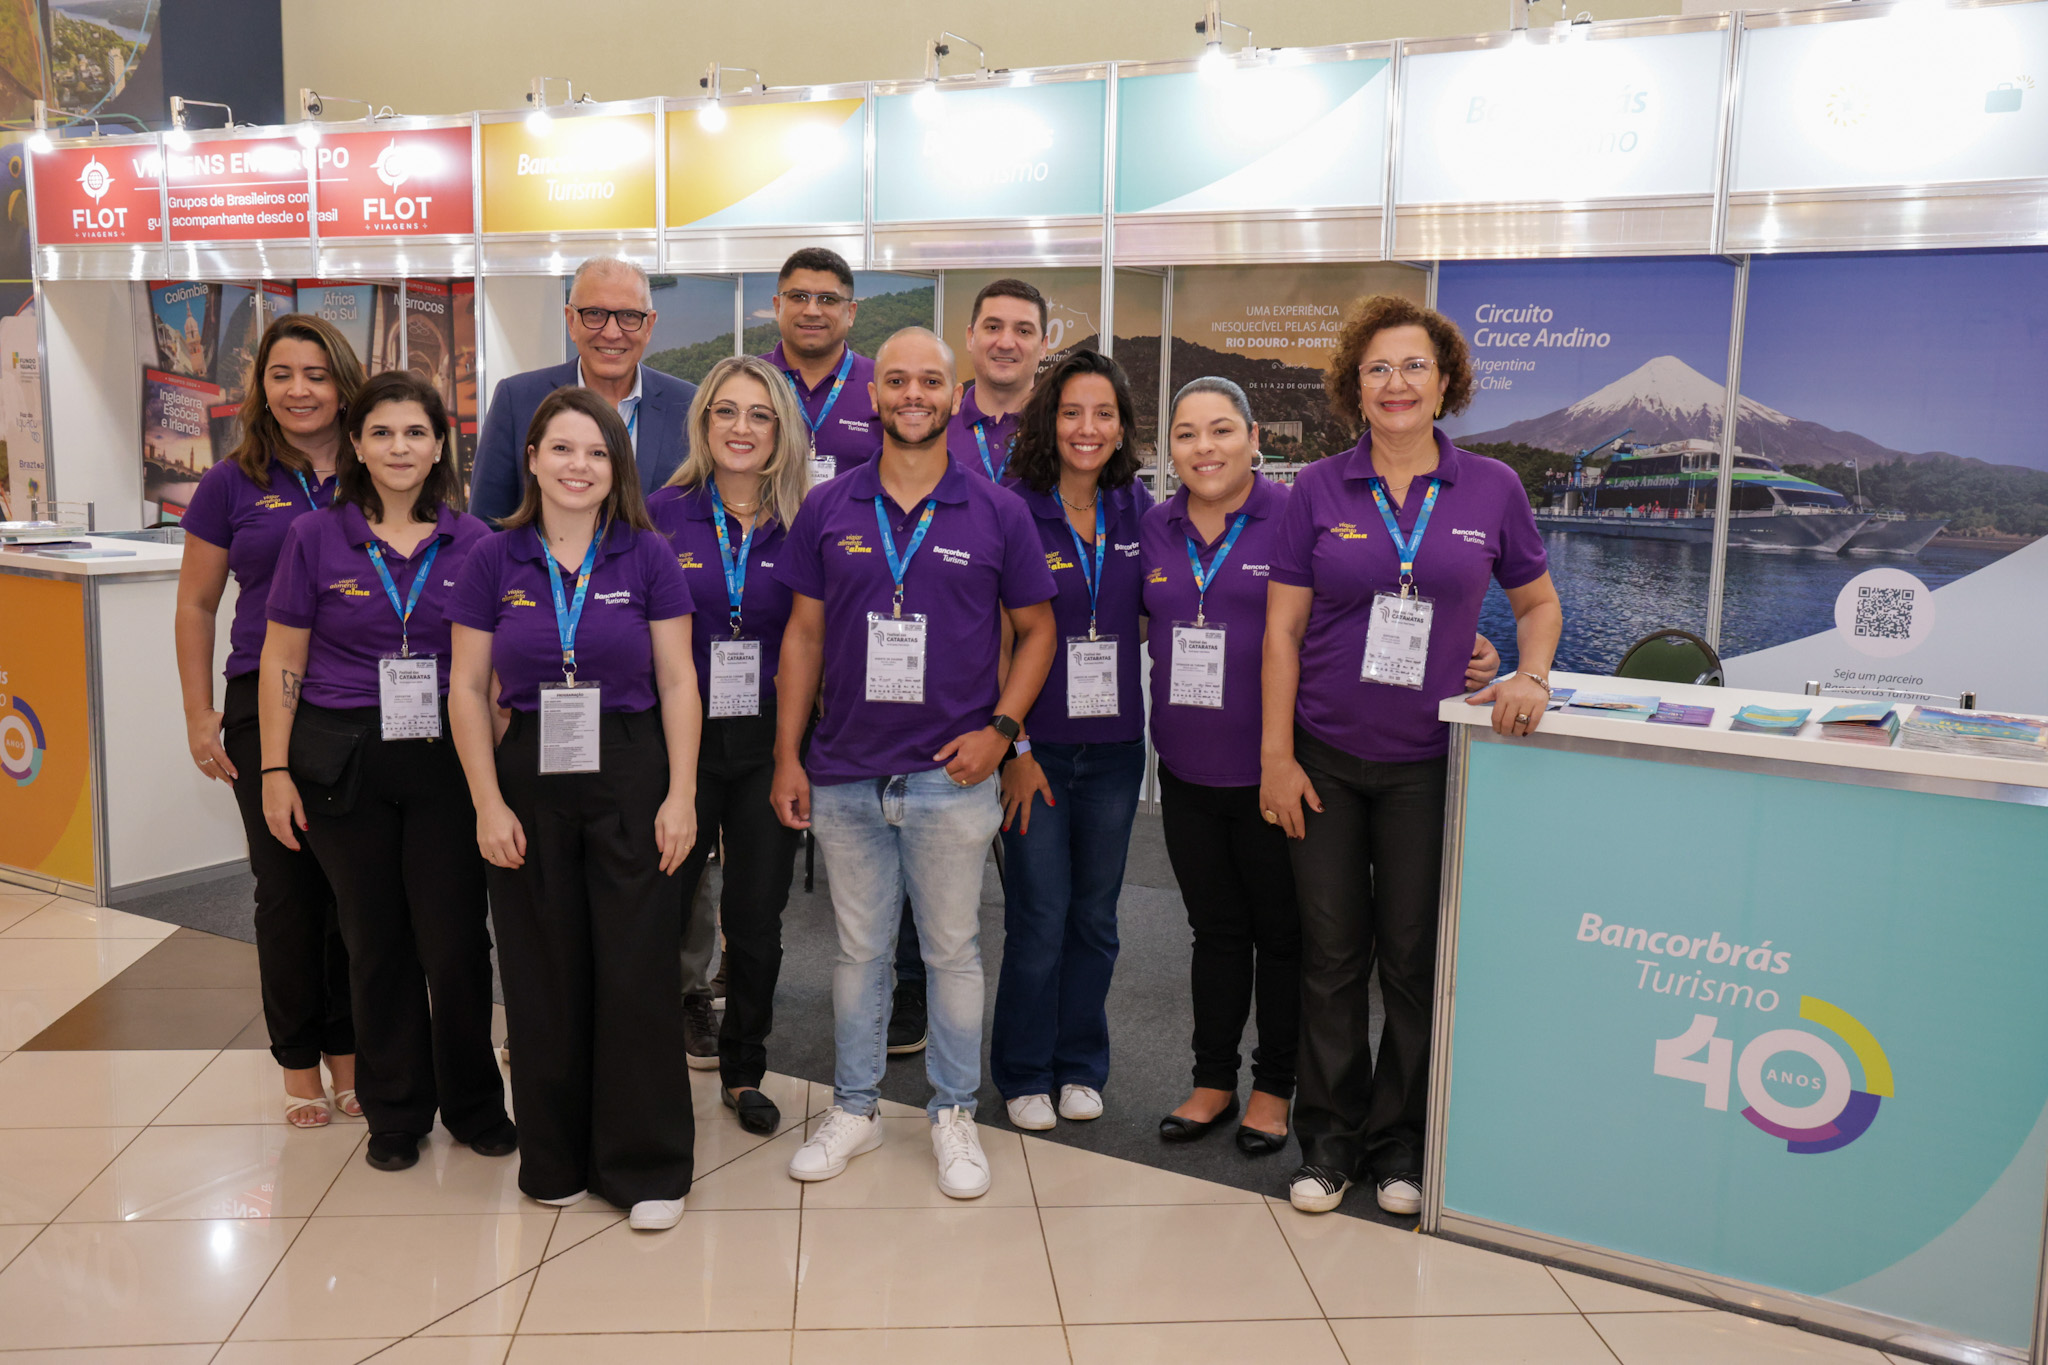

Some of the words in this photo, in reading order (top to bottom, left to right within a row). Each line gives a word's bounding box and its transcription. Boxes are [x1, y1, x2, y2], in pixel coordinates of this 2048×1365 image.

[546, 178, 615, 200] Turismo
[168, 196, 208, 210] Grupos
[210, 194, 225, 207] de
[227, 191, 286, 206] Brasileiros
[363, 196, 432, 221] FLOT
[72, 207, 128, 230] FLOT
[172, 211, 255, 228] acompanhante
[257, 210, 293, 224] desde
[295, 213, 305, 223] o
[373, 222, 419, 231] VIAGENS
[164, 282, 209, 305] Colômbia
[324, 290, 355, 306] África
[249, 296, 278, 312] Peru
[1246, 305, 1271, 316] UMA
[1273, 304, 1340, 316] EXPERIÊNCIA
[322, 308, 338, 321] do
[339, 307, 357, 321] Sul
[1475, 303, 1554, 324] Circuito
[1211, 320, 1281, 333] INESQUECÍVEL
[1285, 321, 1317, 332] PELAS
[1225, 337, 1246, 348] RIO
[1247, 337, 1289, 348] DOURO
[1473, 327, 1531, 348] Cruce
[1533, 327, 1611, 348] Andino
[1472, 357, 1536, 374] Argentina
[1470, 379, 1479, 390] e
[1480, 376, 1513, 390] Chile
[160, 388, 205, 411] Inglaterra,
[163, 403, 200, 422] Escócia
[161, 418, 168, 428] e
[169, 419, 200, 436] Irlanda
[838, 418, 869, 428] Bancorbrás
[847, 424, 869, 433] Turismo
[1614, 477, 1639, 490] Lagos
[1640, 475, 1680, 487] Andinos
[269, 501, 292, 509] alma
[1343, 531, 1368, 540] alma
[1451, 528, 1487, 539] Bancorbrás
[1463, 535, 1485, 546] Turismo
[849, 545, 872, 553] alma
[933, 545, 971, 560] Bancorbrás
[1114, 541, 1140, 551] Bancorbr
[942, 554, 968, 566] Turismo
[1051, 561, 1074, 571] alma
[1242, 563, 1270, 571] Bancorb
[345, 588, 370, 596] alma
[594, 590, 631, 600] Bancorbrás
[514, 598, 536, 607] alma
[605, 597, 630, 605] Turismo
[1833, 668, 1856, 682] Seja
[1858, 673, 1876, 681] um
[1877, 674, 1924, 686] parceiro
[6, 739, 25, 750] ANOS
[1576, 912, 1792, 975] Bancorbrás
[1635, 958, 1780, 1012] Turismo
[1653, 1013, 1852, 1130] 40
[1766, 1068, 1821, 1090] ANOS
